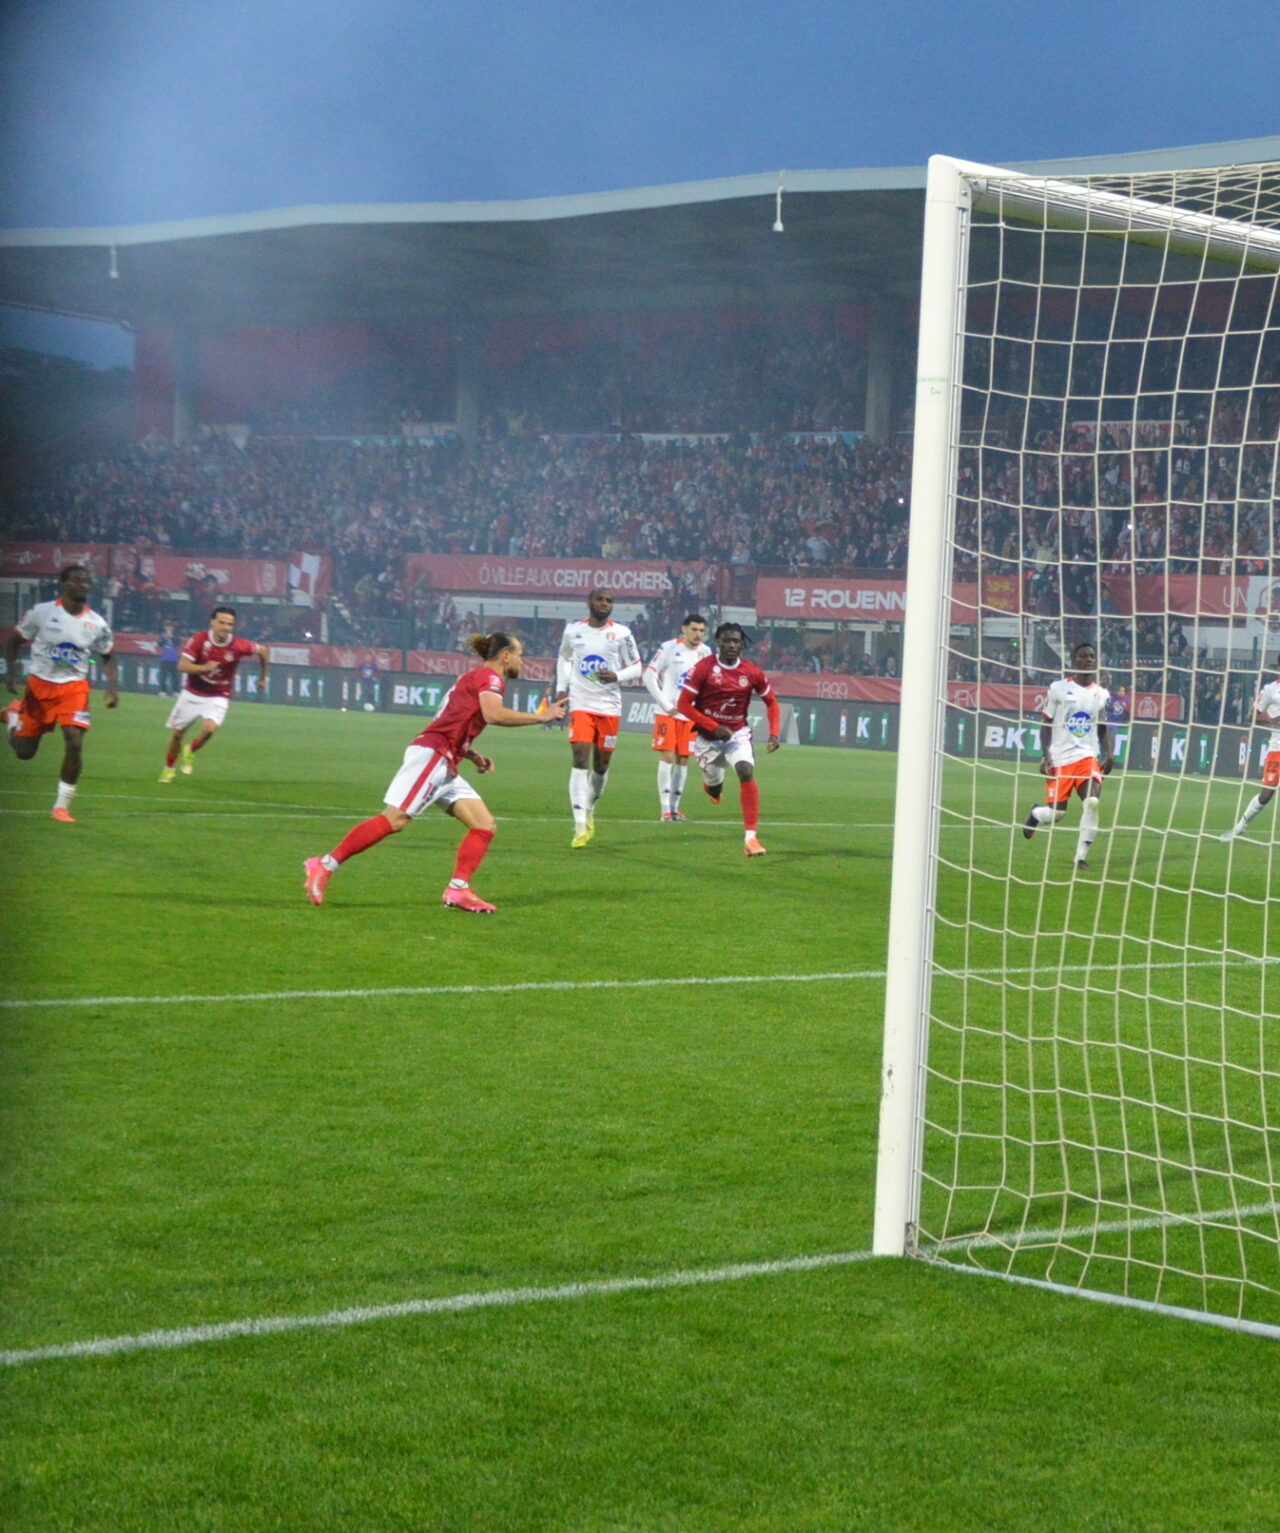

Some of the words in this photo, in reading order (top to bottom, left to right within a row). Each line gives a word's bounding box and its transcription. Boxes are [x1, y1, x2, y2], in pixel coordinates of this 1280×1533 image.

[526, 568, 550, 587] AUX
[554, 569, 591, 587] CENT
[594, 570, 672, 590] CLOCHERS
[784, 588, 805, 607] 12
[394, 685, 441, 706] BKT
[815, 681, 848, 699] 1899
[984, 725, 1041, 750] BKT
